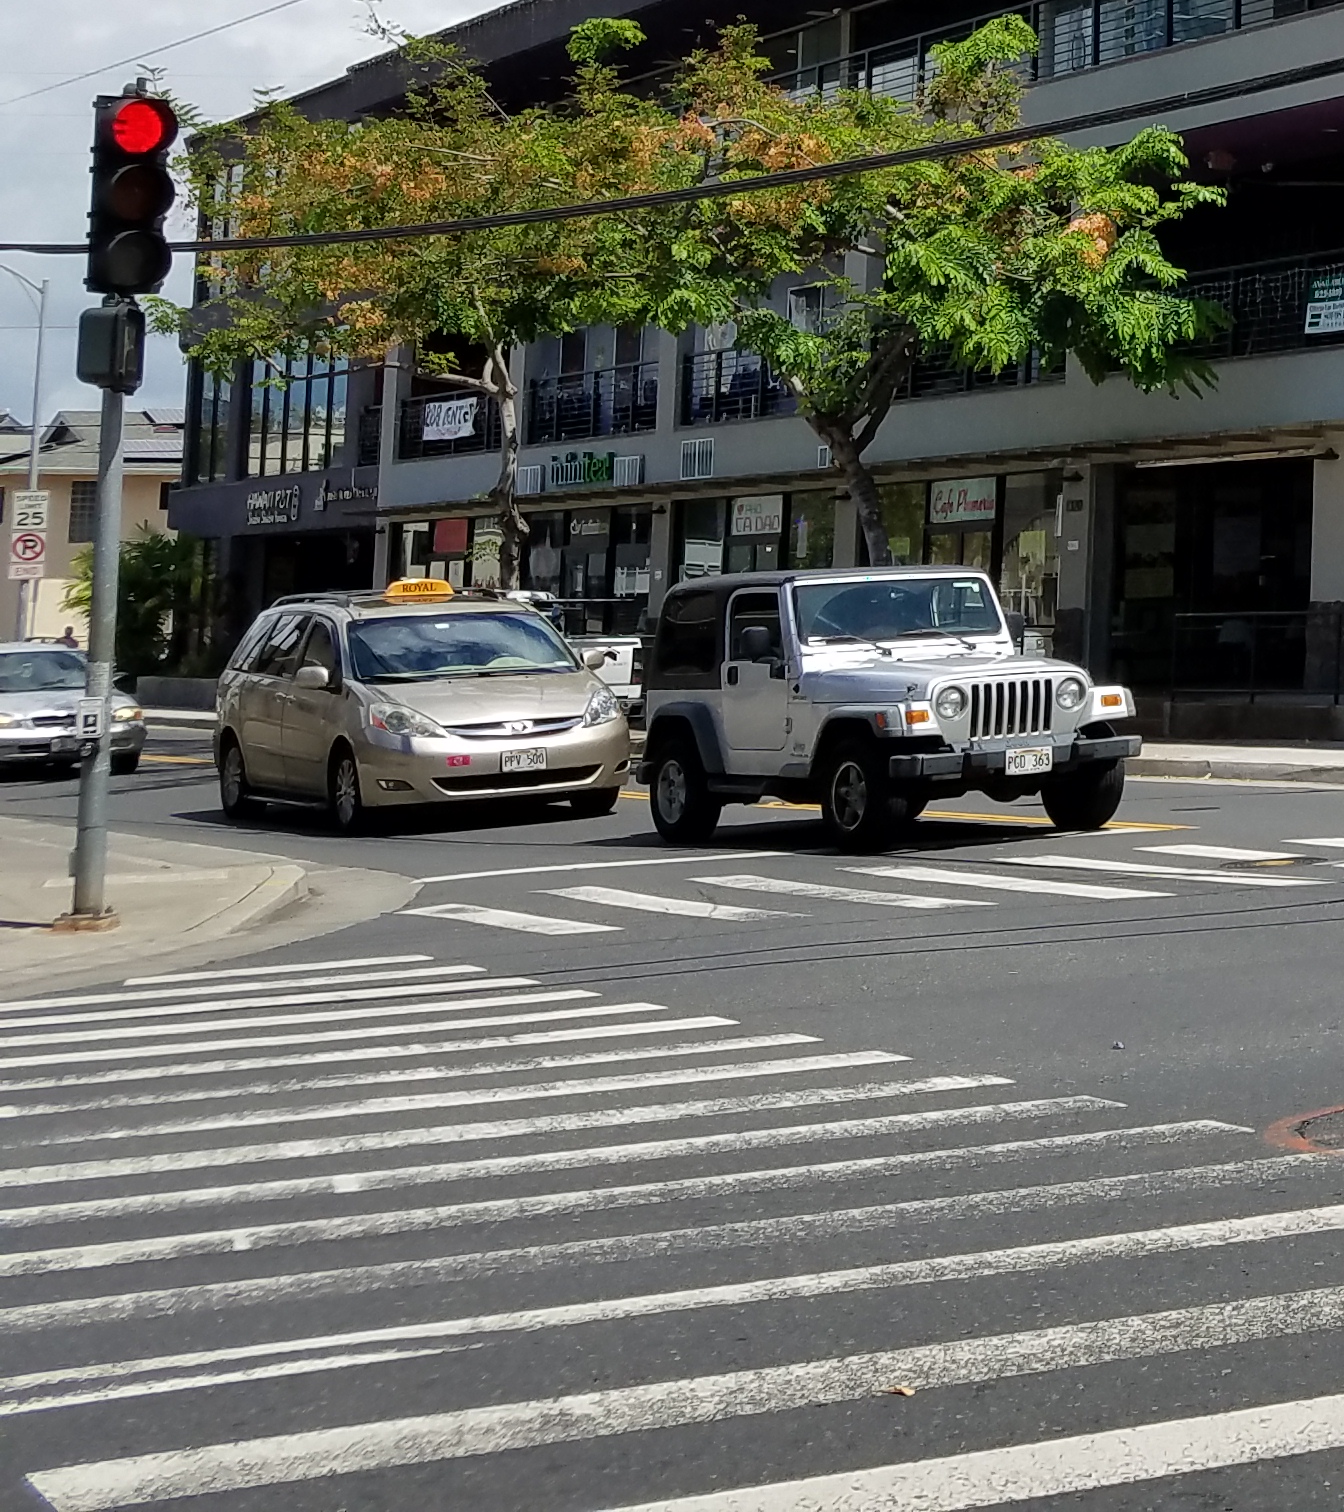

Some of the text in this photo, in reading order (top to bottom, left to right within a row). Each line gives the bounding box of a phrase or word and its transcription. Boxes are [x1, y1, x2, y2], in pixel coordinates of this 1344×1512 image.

[16, 511, 44, 526] 25
[402, 582, 437, 593] ROYAL
[504, 752, 544, 767] PPV 500
[1007, 752, 1050, 770] PGD 363
